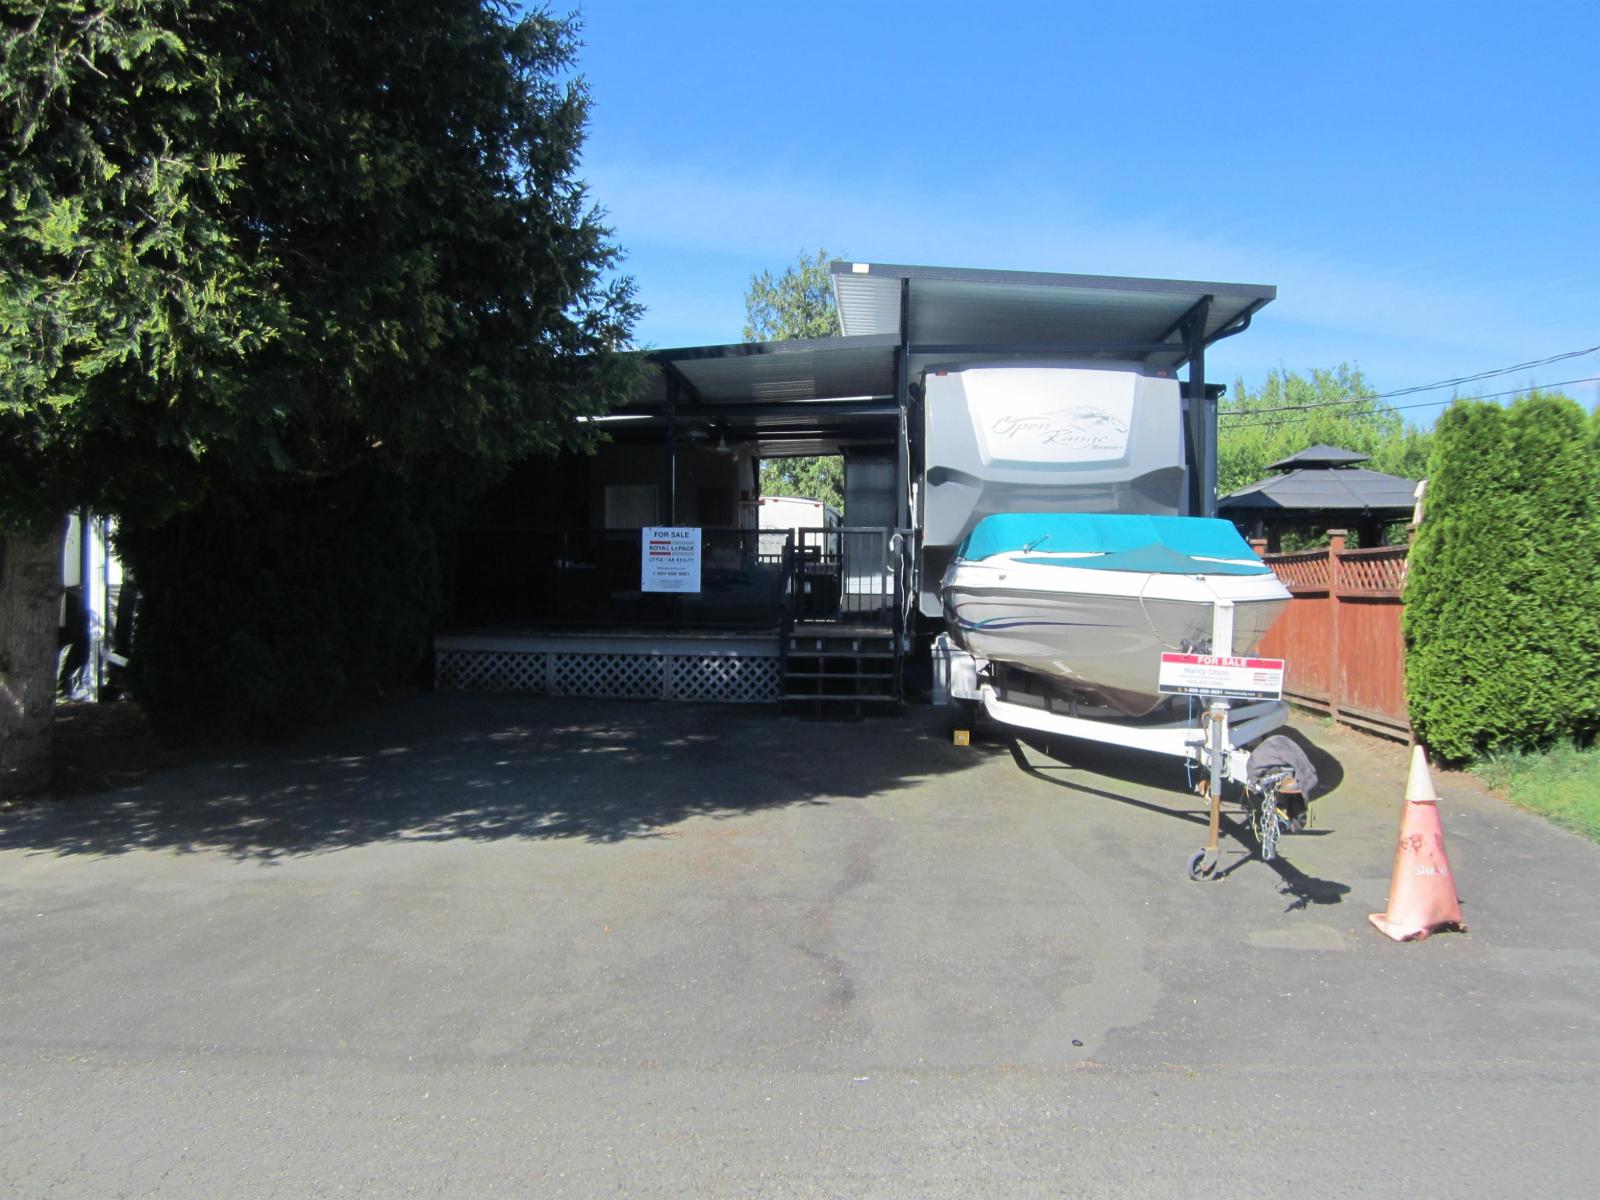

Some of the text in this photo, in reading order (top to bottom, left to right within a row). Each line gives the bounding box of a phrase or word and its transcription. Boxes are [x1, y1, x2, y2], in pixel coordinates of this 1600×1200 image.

[992, 416, 1050, 438] Open
[1198, 656, 1247, 667] FOR SALE
